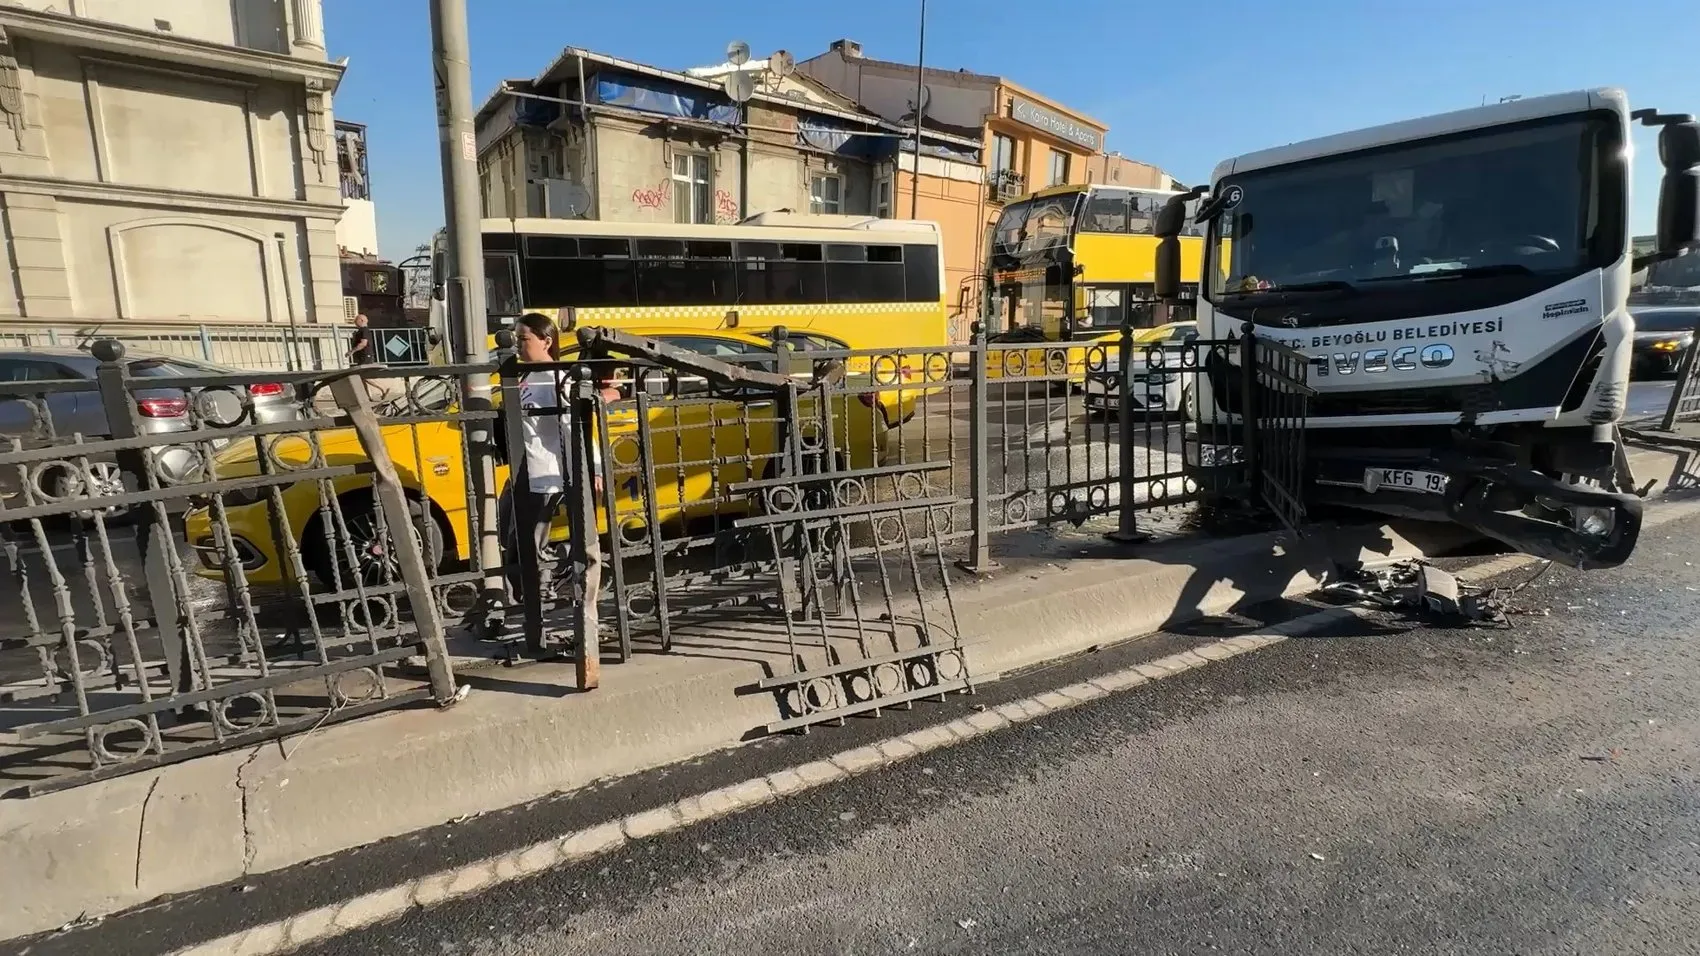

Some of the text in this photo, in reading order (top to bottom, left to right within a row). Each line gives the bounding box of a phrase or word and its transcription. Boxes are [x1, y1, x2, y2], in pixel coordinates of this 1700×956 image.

[1051, 115, 1067, 133] Hotel
[1068, 124, 1074, 136] &
[1312, 329, 1386, 348] BEYOĞLU
[1393, 317, 1503, 340] BELEDİYESİ
[1317, 343, 1455, 376] IVECO
[1383, 470, 1413, 485] KFG
